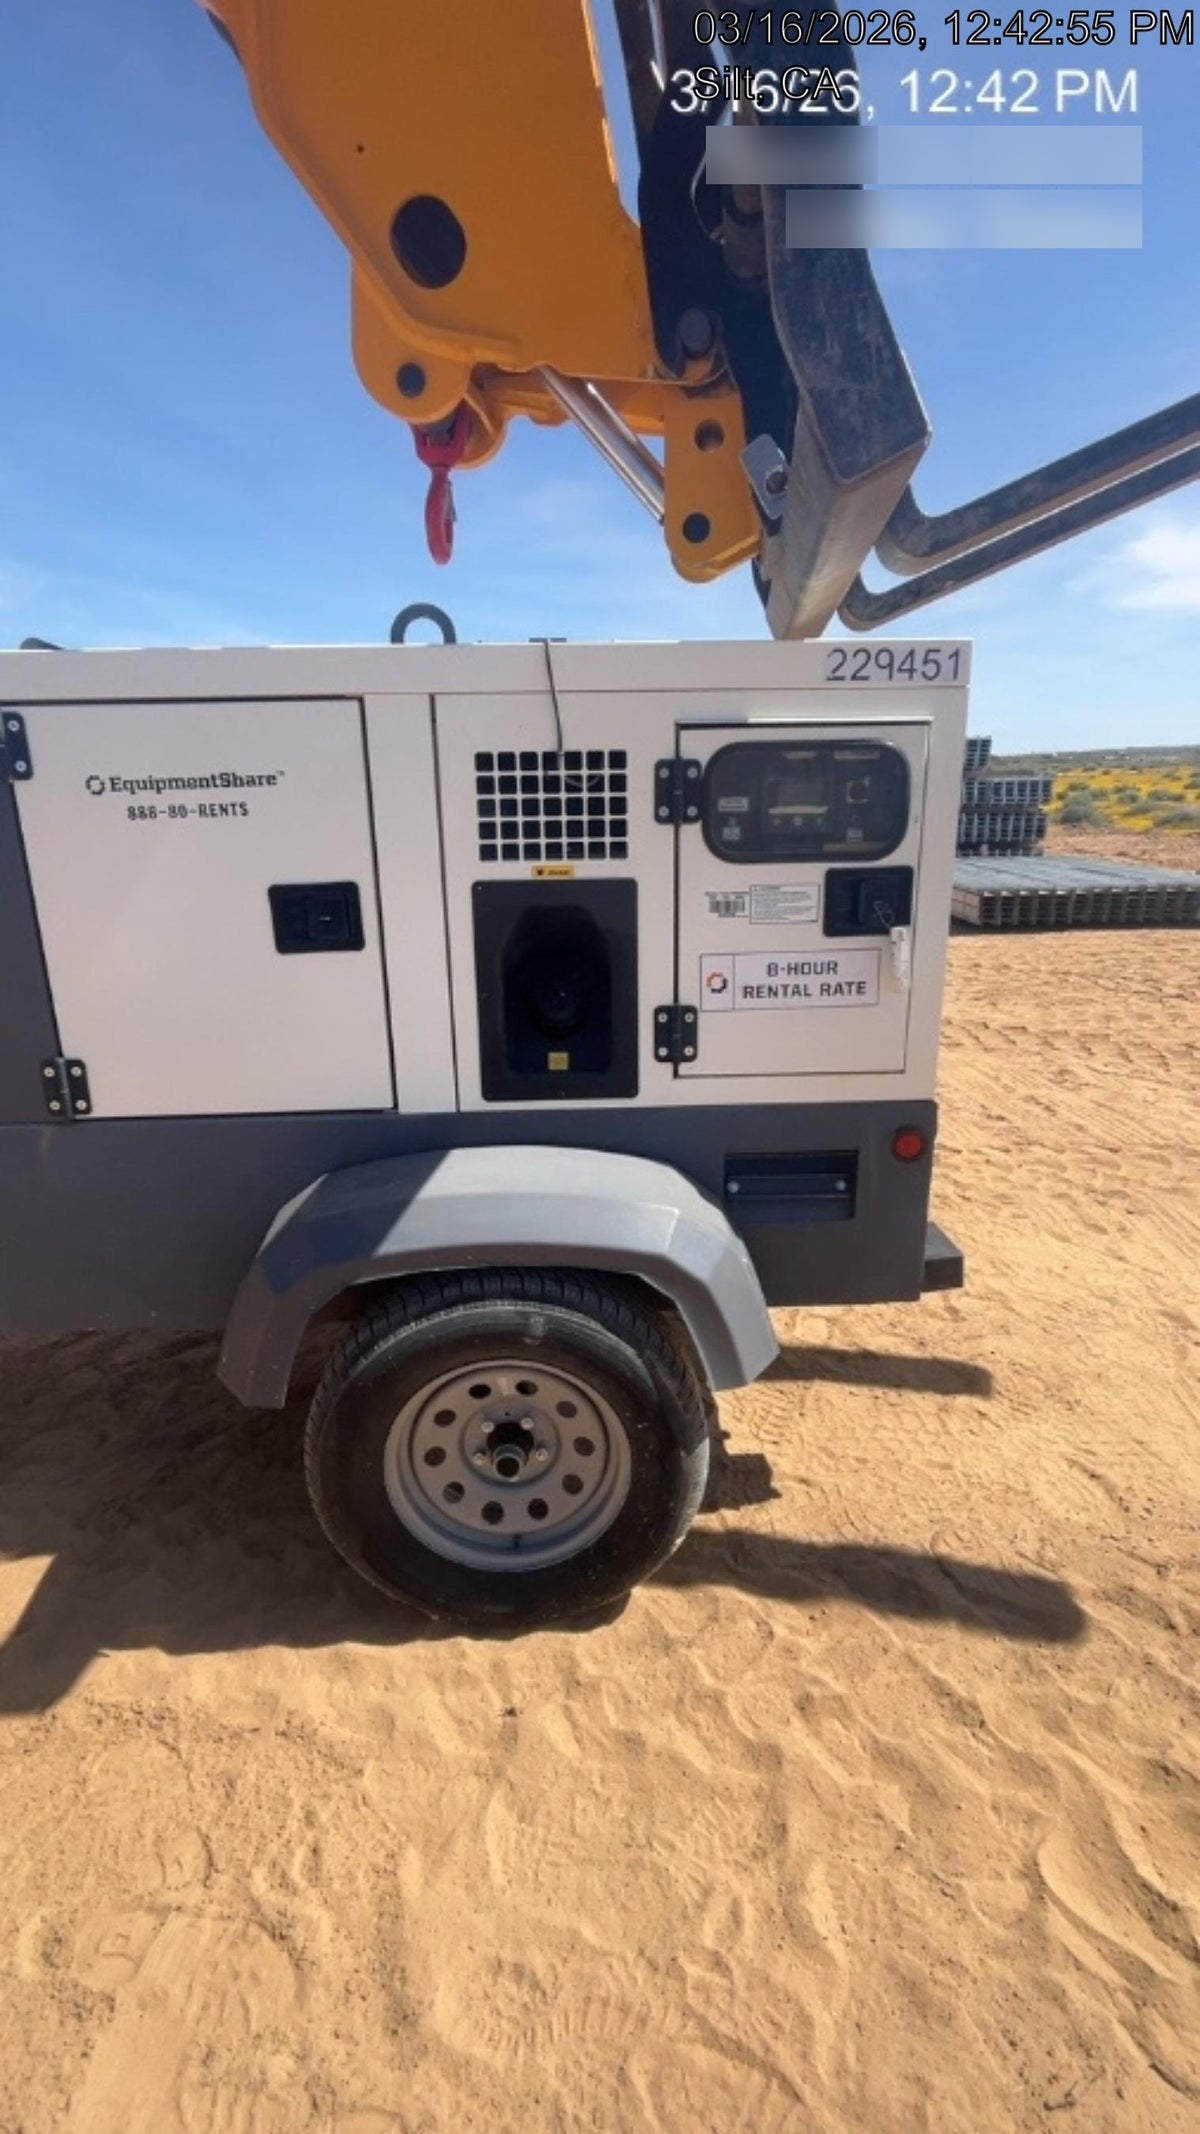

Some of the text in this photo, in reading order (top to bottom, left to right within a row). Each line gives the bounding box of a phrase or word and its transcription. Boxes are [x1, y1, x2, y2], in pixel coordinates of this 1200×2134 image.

[826, 647, 961, 681] 229451
[109, 771, 278, 795] EquipmentShare
[766, 960, 839, 977] 8-HOUR
[742, 980, 868, 999] RENTAL RATE
